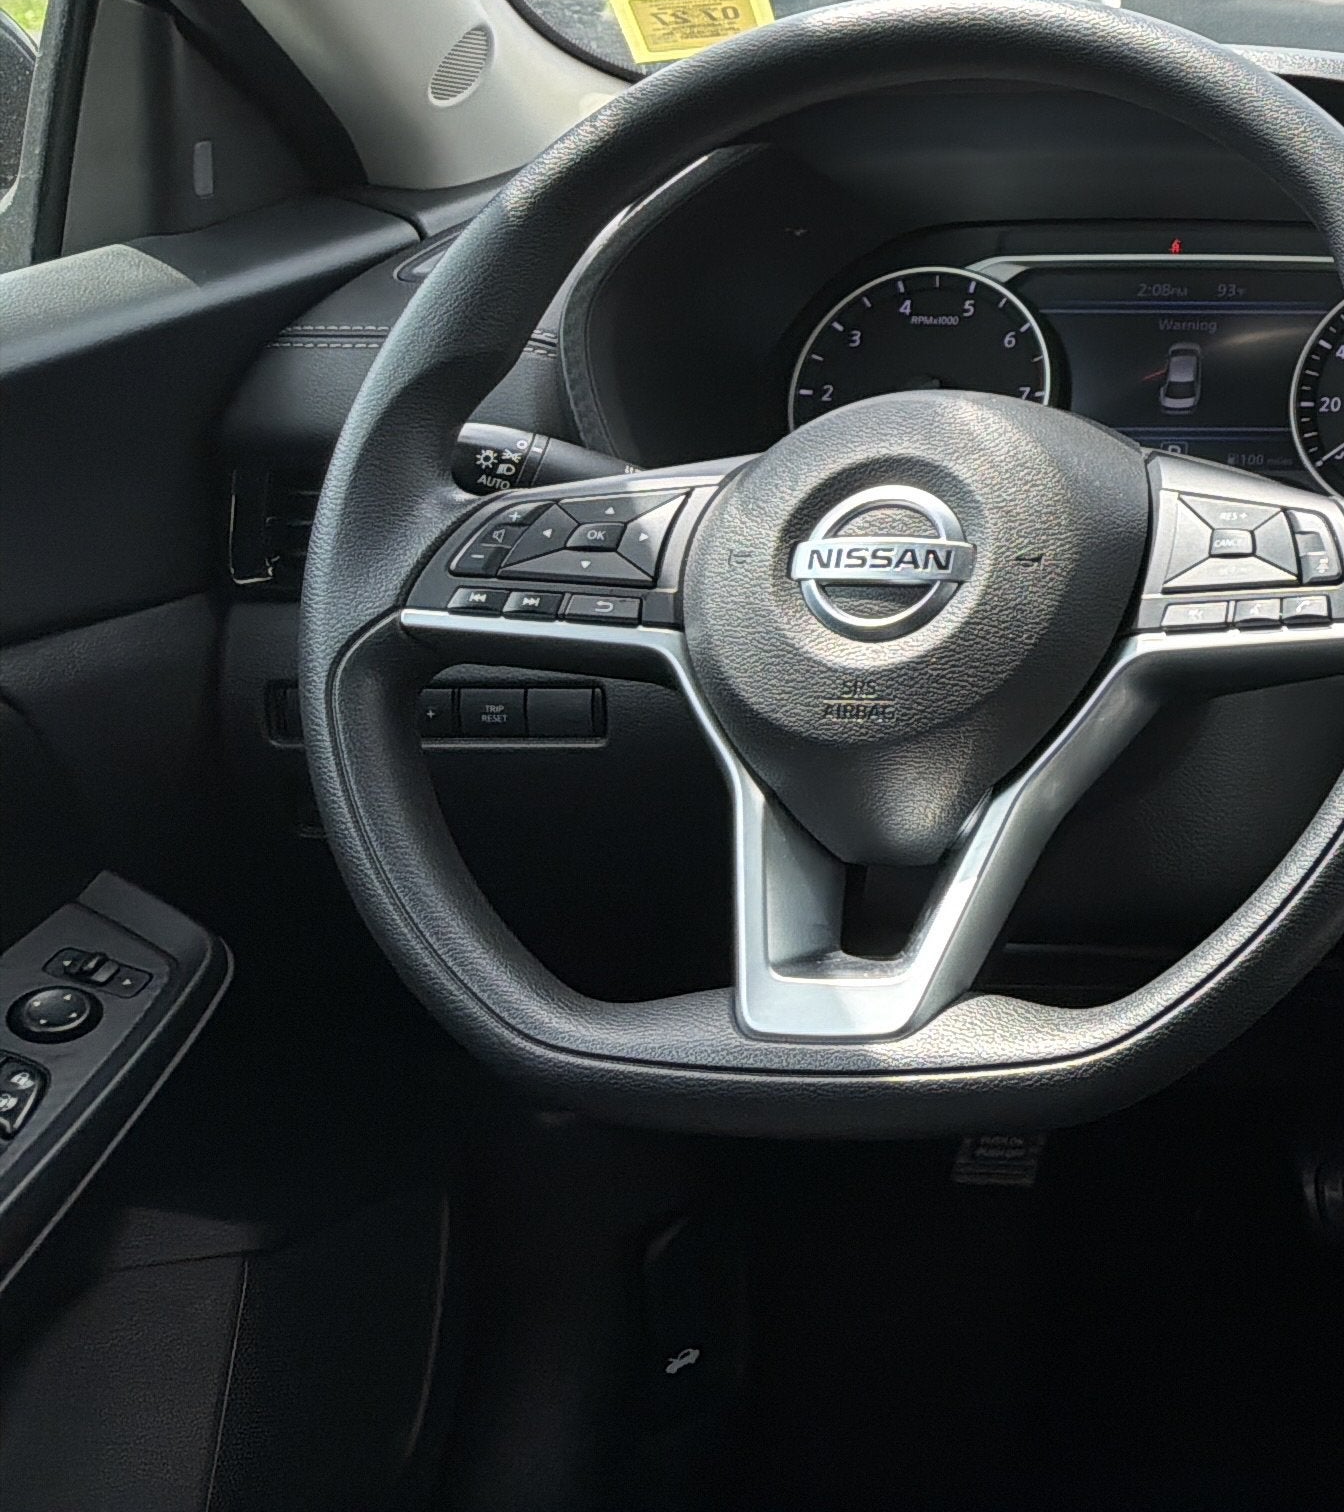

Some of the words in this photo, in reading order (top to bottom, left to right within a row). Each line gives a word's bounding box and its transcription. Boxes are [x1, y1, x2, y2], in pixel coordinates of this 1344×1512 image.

[899, 299, 912, 316] 4
[963, 300, 975, 317] 5
[1158, 319, 1218, 334] Warning
[849, 330, 862, 347] 3
[1003, 332, 1016, 348] 6
[821, 384, 834, 402] 2
[1319, 396, 1341, 413] 20
[1241, 453, 1264, 465] 100
[476, 474, 511, 490] AUTO
[586, 528, 606, 542] OK
[807, 546, 954, 572] NISSAN
[485, 704, 505, 714] TRIP
[481, 714, 508, 723] RESET
